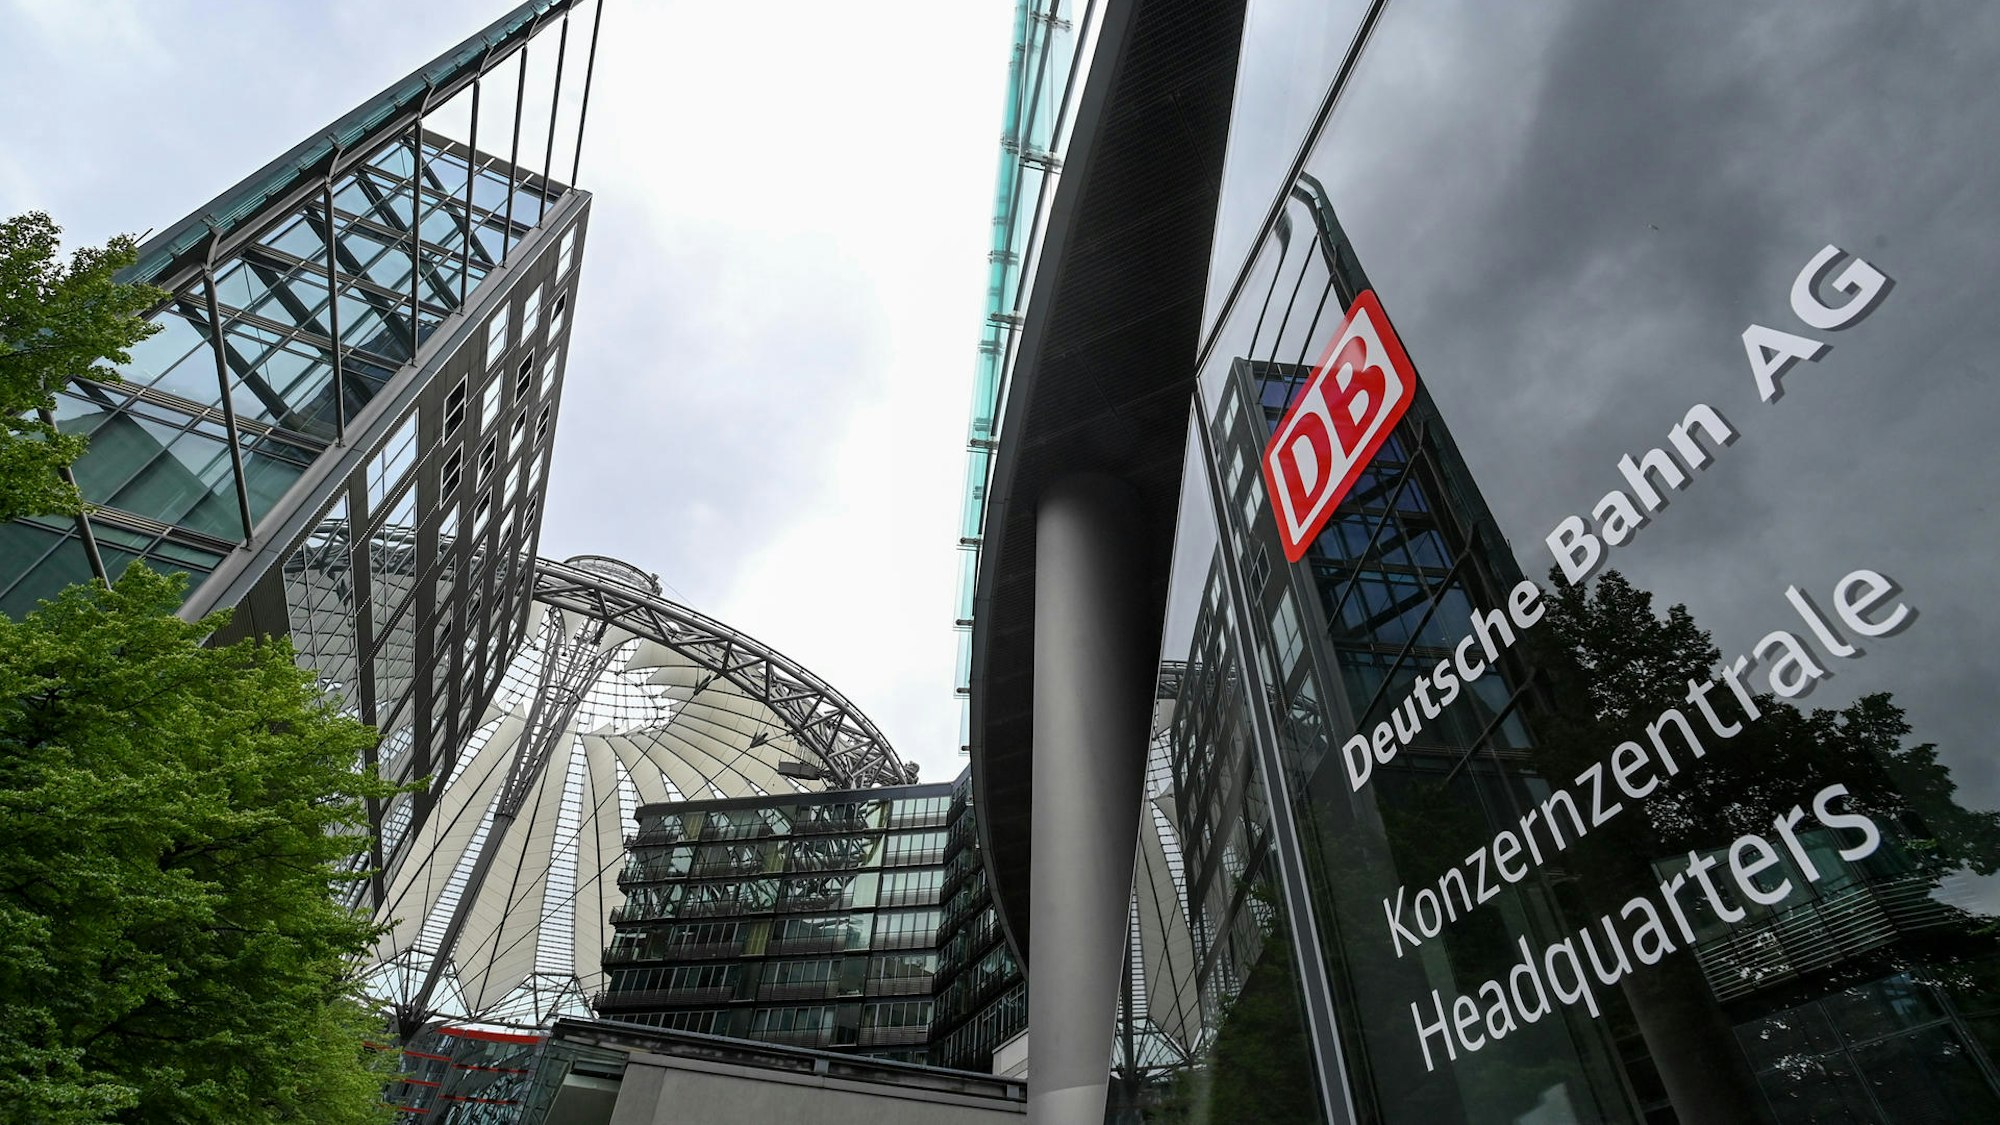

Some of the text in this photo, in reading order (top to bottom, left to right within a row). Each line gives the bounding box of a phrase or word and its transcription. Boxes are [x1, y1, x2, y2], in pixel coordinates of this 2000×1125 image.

[1277, 335, 1386, 528] DB
[1341, 244, 1886, 792] Deutsche Bahn AG
[1382, 569, 1909, 958] Konzernzentrale
[1410, 782, 1881, 1071] Headquarters
